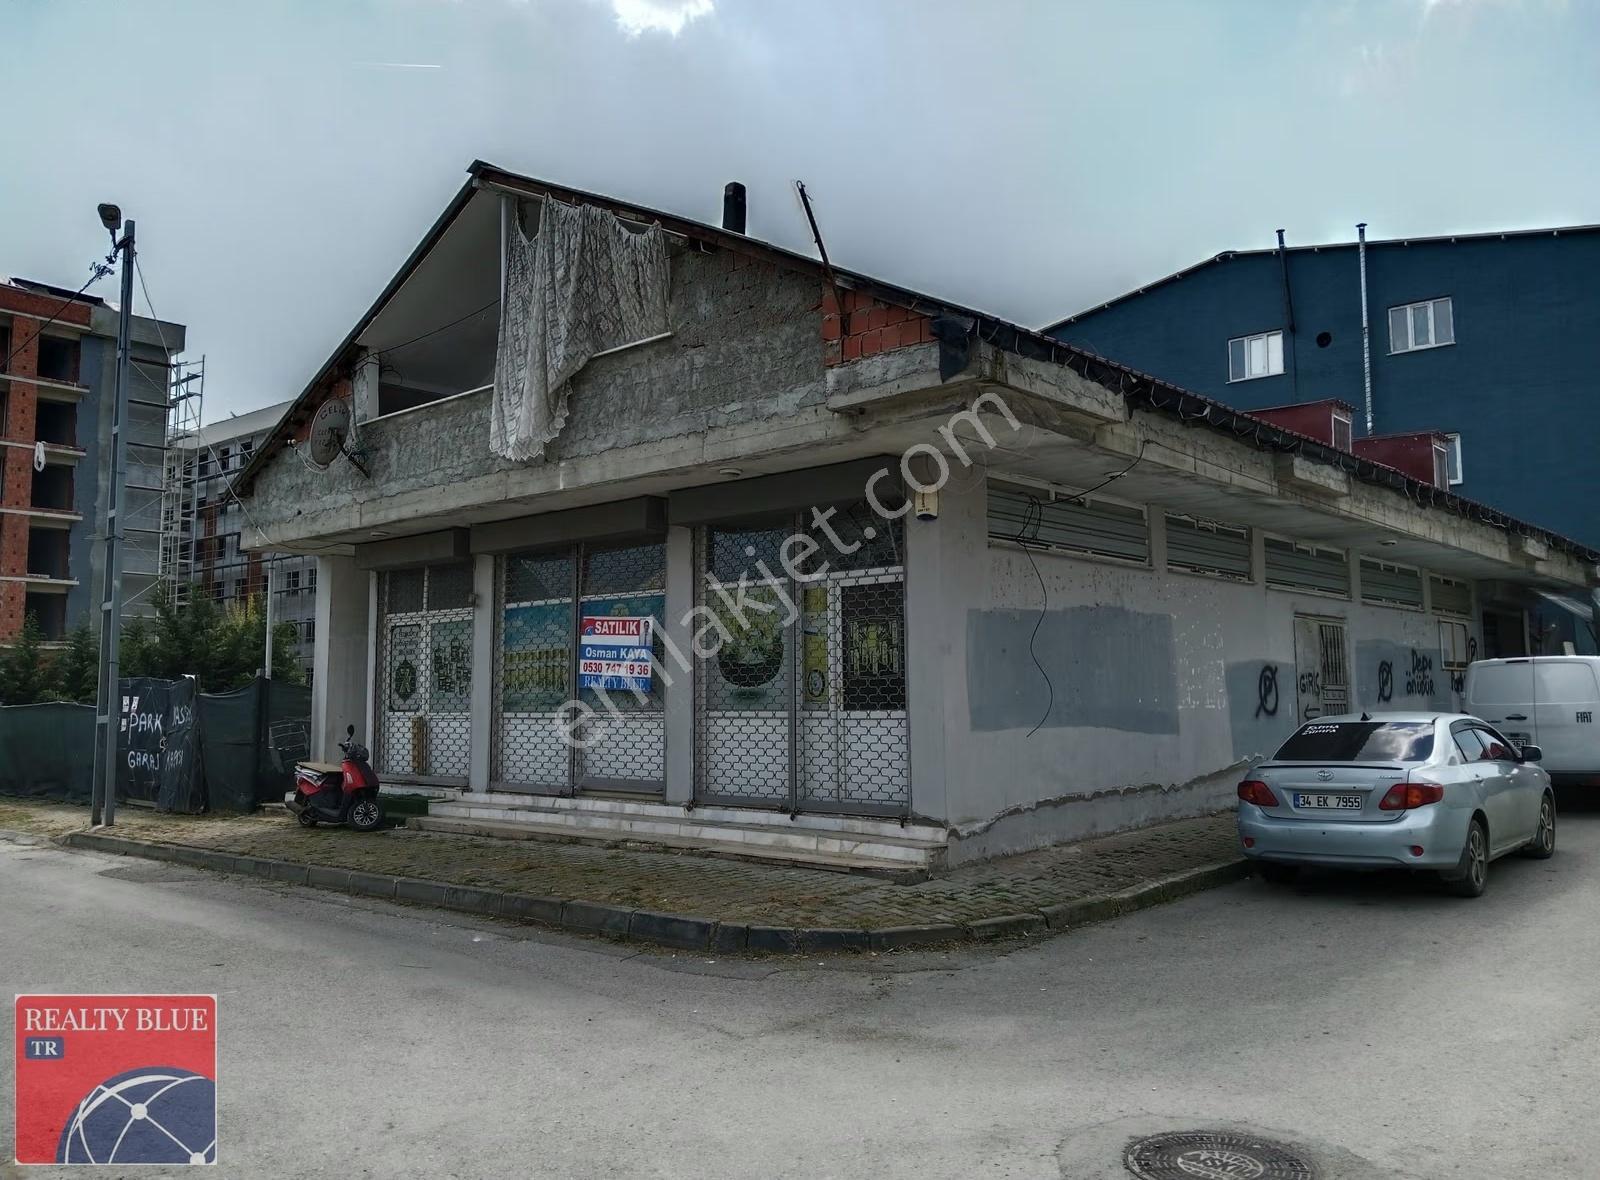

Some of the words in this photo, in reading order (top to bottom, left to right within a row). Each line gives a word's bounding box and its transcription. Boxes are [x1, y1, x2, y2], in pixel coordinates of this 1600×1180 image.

[594, 621, 638, 635] SATILIK
[585, 647, 617, 659] Osman
[620, 648, 648, 659] KAYA
[1411, 648, 1433, 675] Depo
[583, 662, 602, 673] 0530
[605, 663, 622, 674] 747
[625, 664, 635, 674] 19
[637, 665, 649, 675] 36
[1575, 711, 1592, 723] FIAT
[127, 712, 163, 745] PARK
[127, 750, 160, 771] GARAJ
[1300, 795, 1311, 807] 34
[1317, 796, 1329, 807] EK
[1335, 796, 1360, 808] 7955
